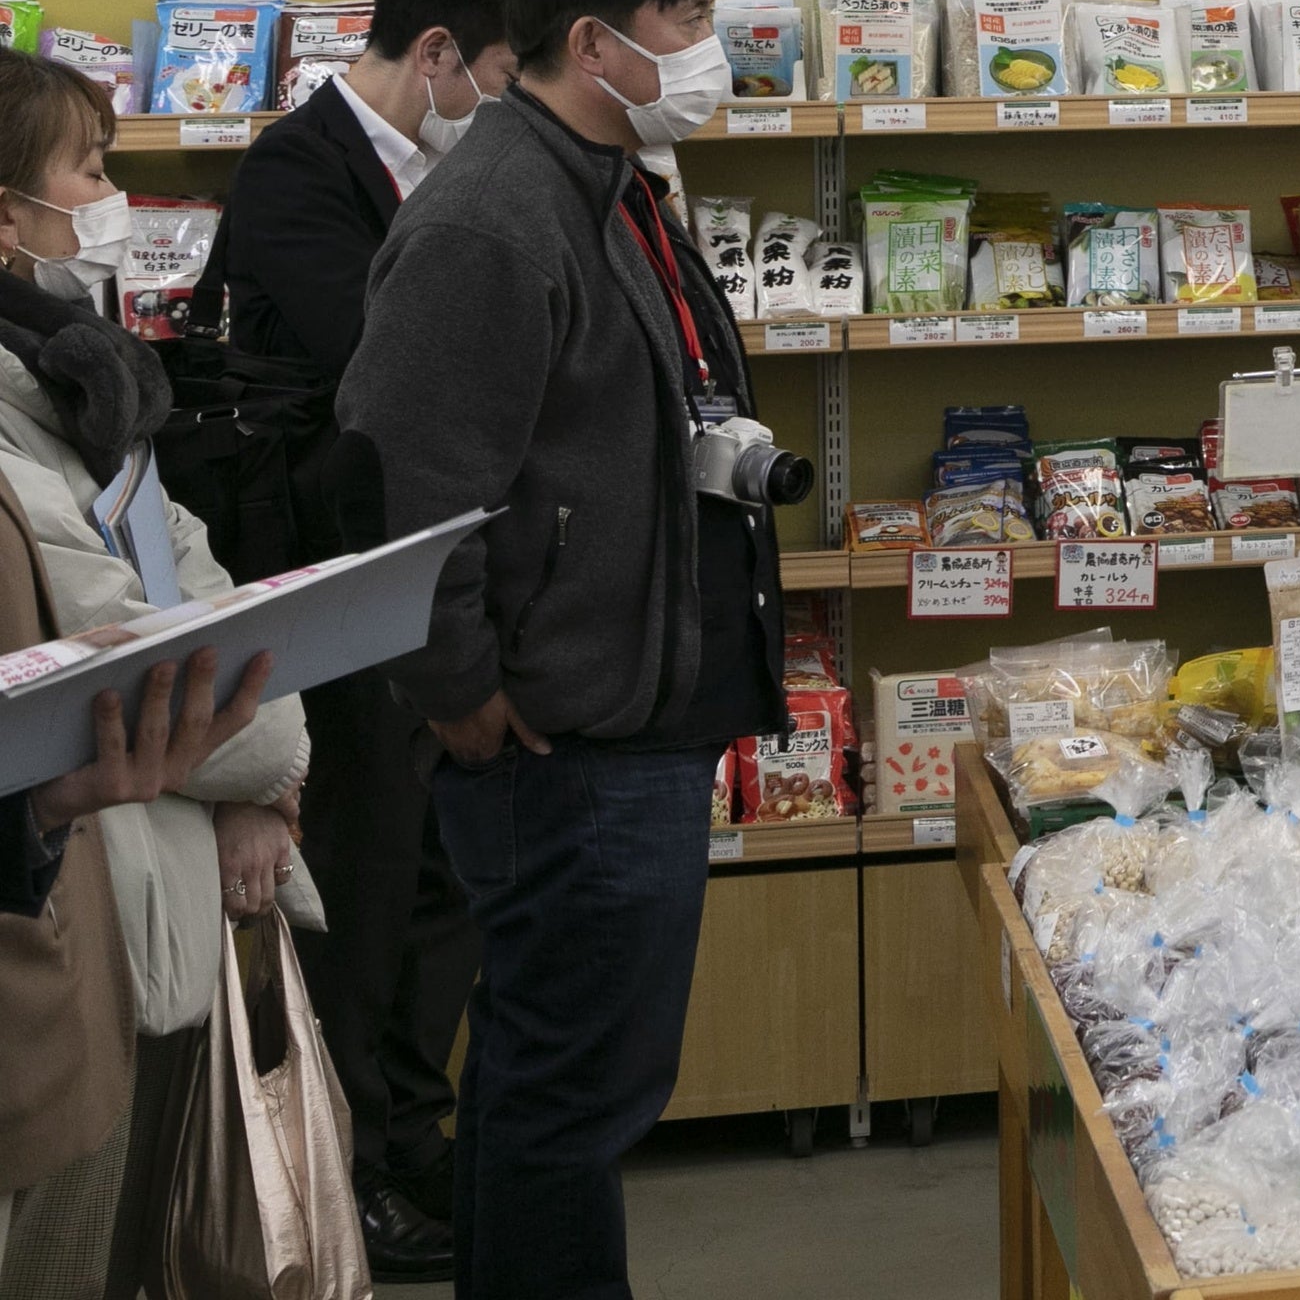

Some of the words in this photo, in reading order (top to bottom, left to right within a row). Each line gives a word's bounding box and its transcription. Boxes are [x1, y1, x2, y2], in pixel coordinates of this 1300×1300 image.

[172, 21, 256, 40] ゼリーの素
[733, 39, 776, 50] かんてん
[217, 135, 234, 143] 432
[143, 262, 182, 273] 白玉粉
[896, 225, 917, 292] 漬の素
[918, 220, 942, 274] 白菜
[1000, 244, 1025, 292] 漬の素
[1018, 242, 1047, 290] からし
[1095, 231, 1117, 291] 漬の素
[1116, 229, 1140, 286] わさび
[1188, 228, 1208, 285] 漬の素
[1208, 225, 1232, 285] だいこん
[1151, 483, 1188, 494] カレー
[1105, 587, 1150, 604] 324円
[911, 699, 966, 719] 三温糖
